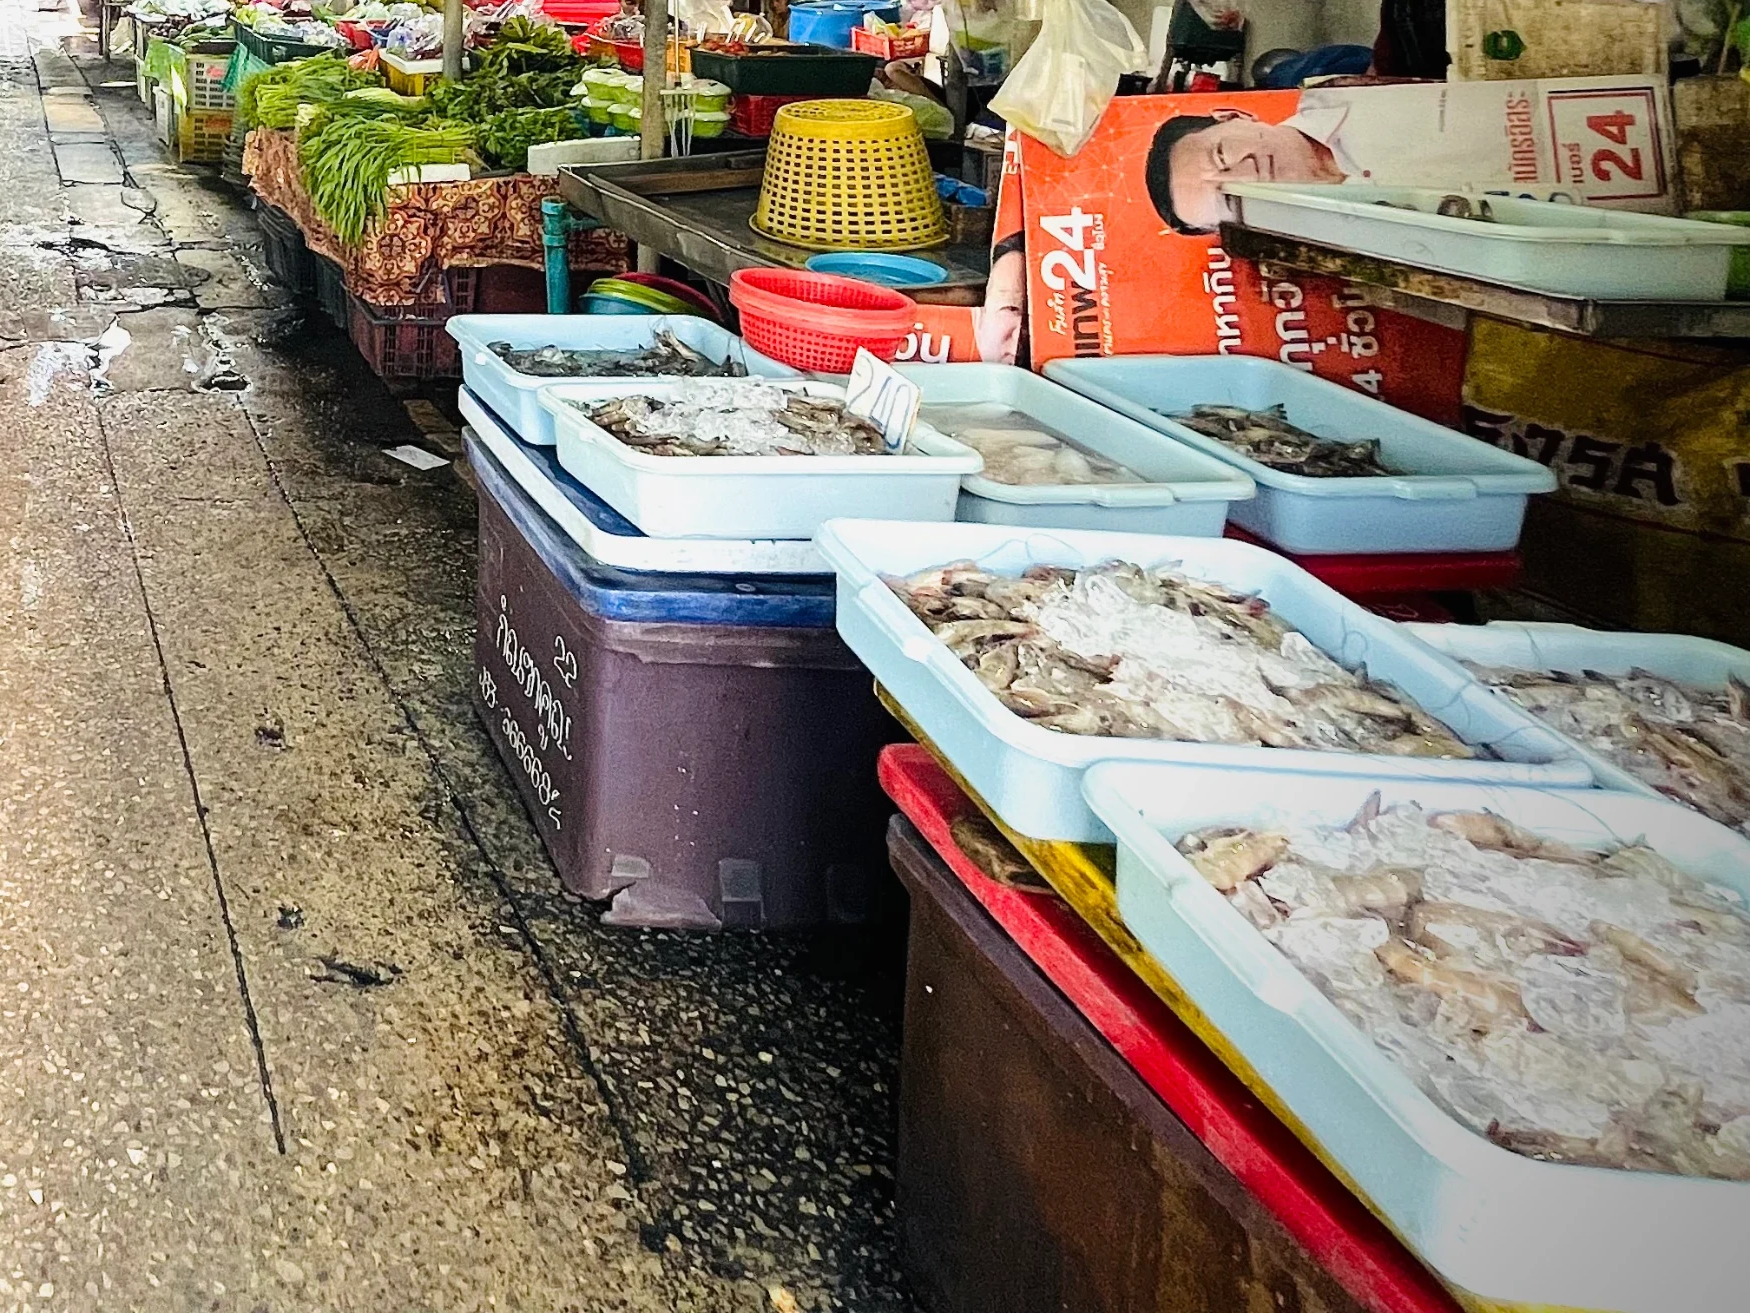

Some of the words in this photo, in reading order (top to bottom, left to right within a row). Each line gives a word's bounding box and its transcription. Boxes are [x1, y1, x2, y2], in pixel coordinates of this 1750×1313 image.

[1561, 142, 1585, 184] เบอร์
[1586, 109, 1644, 182] 24
[1039, 206, 1098, 291] 24
[1351, 369, 1384, 401] 4
